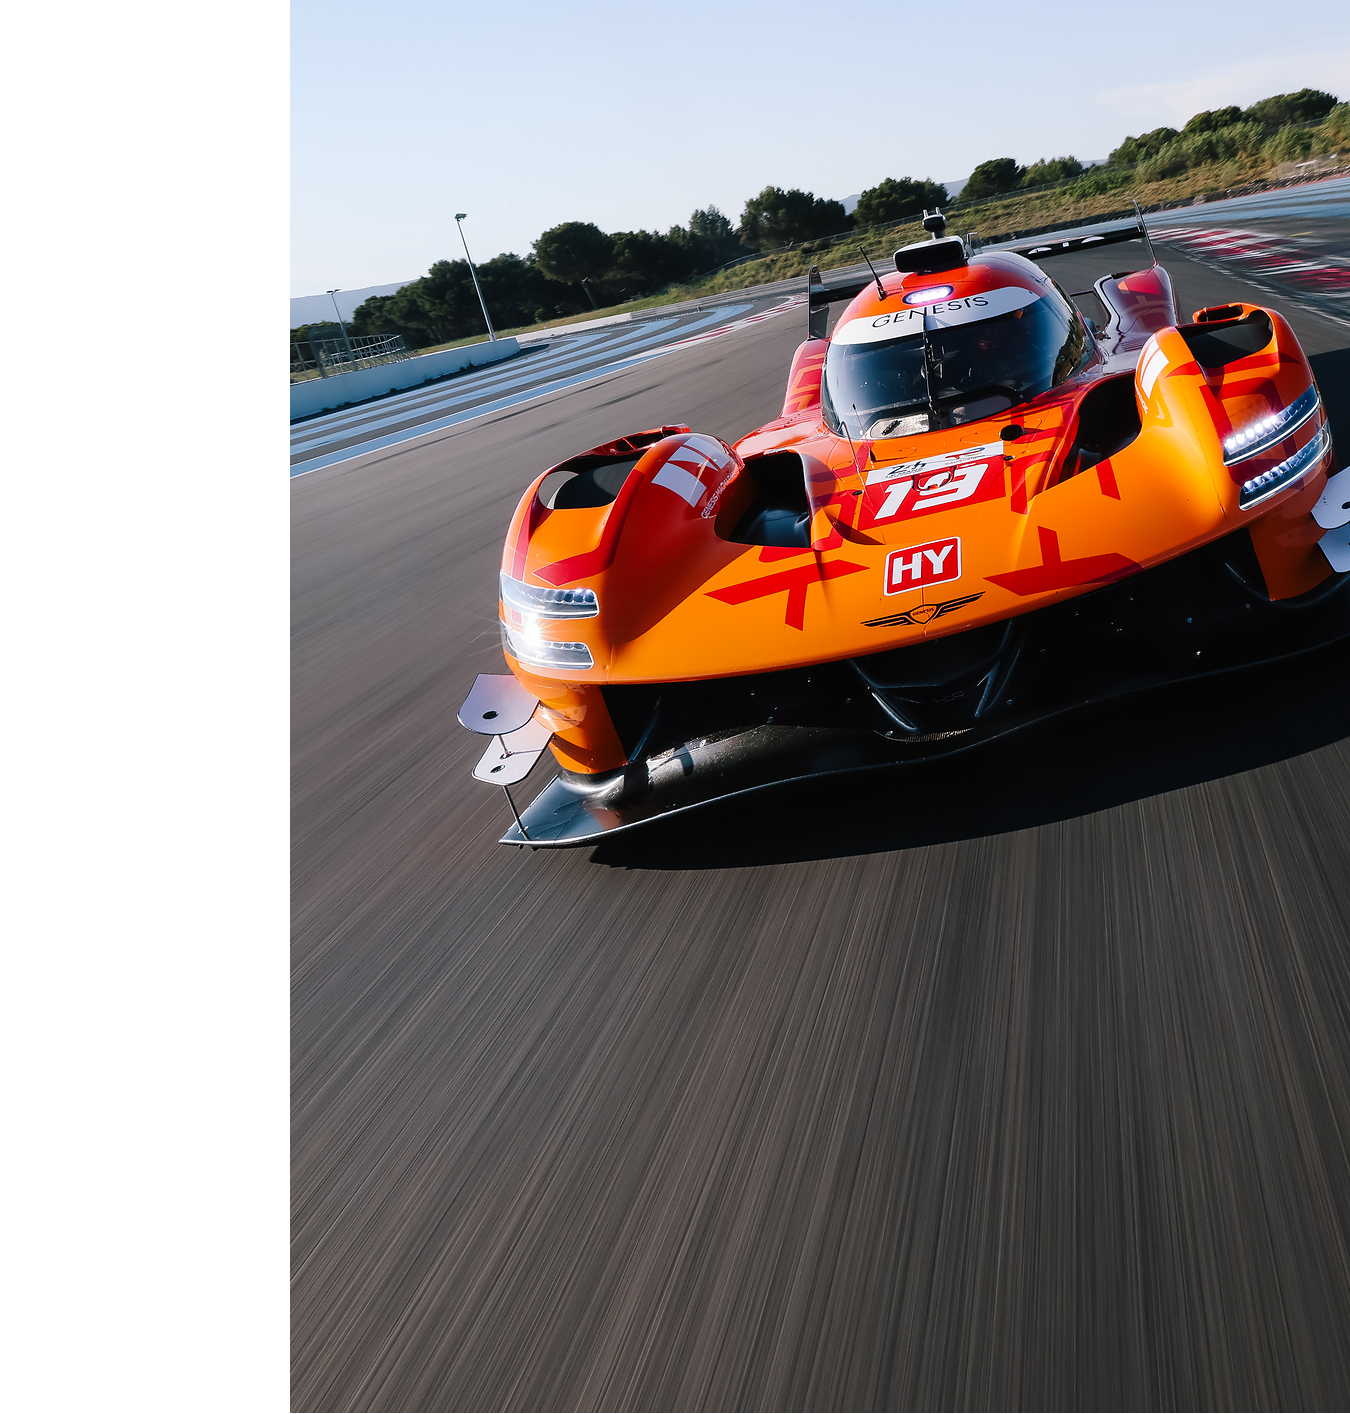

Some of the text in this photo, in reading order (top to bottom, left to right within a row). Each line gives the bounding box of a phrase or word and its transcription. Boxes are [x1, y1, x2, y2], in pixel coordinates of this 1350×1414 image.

[872, 296, 989, 328] GENESIS
[874, 464, 988, 520] 19
[891, 544, 955, 585] HY
